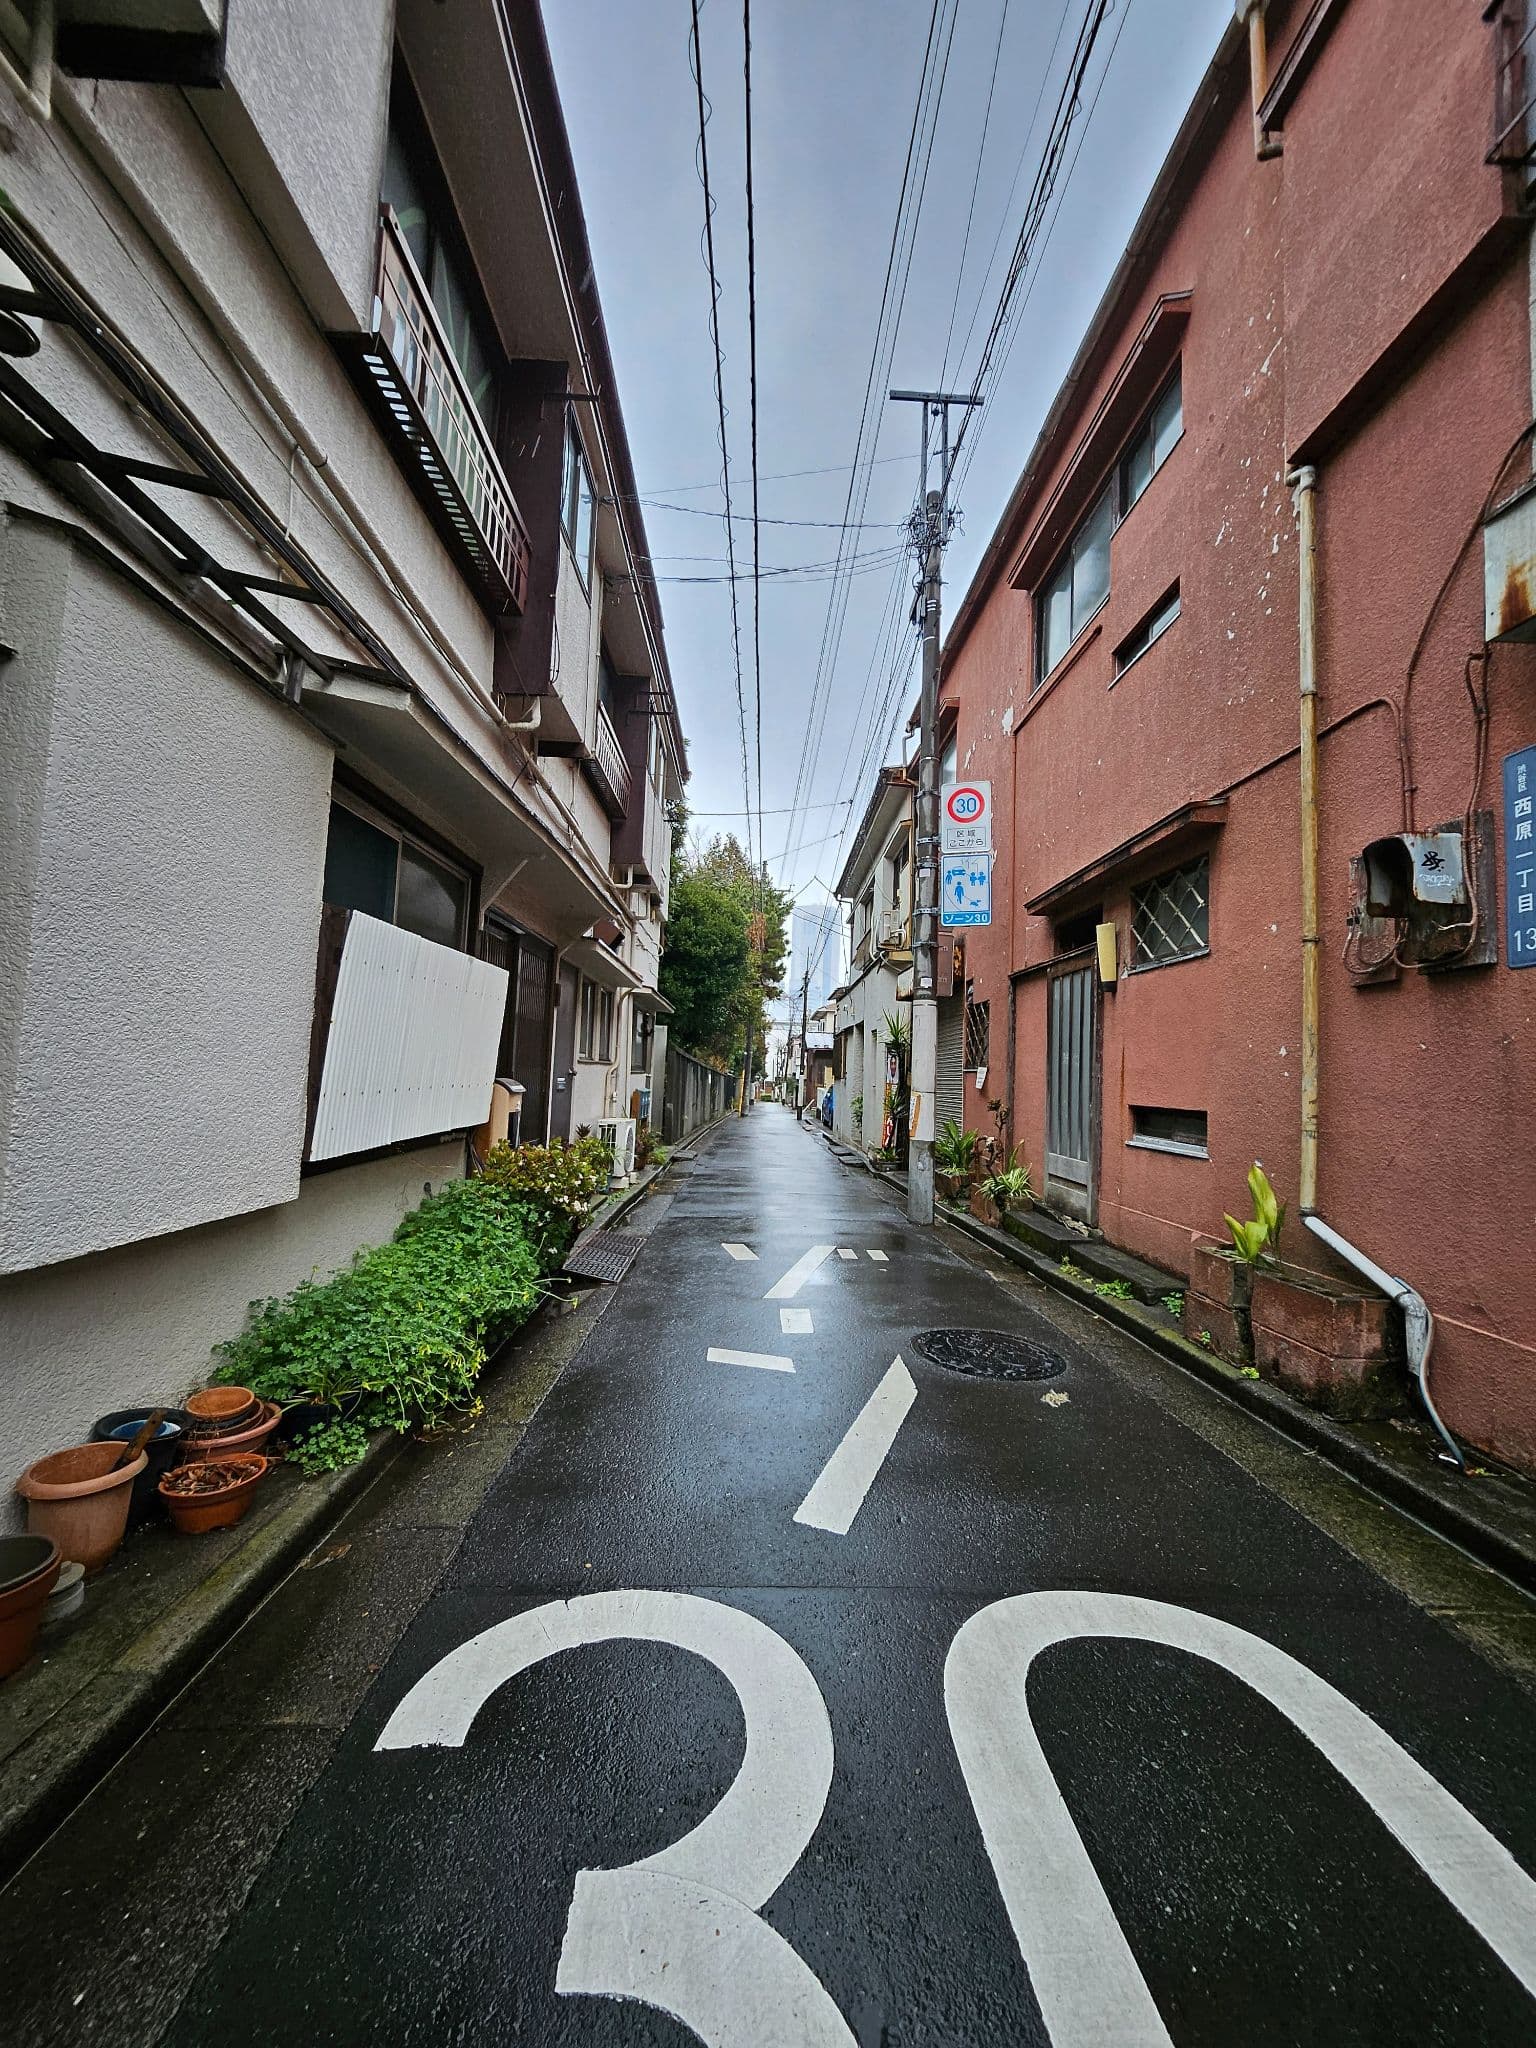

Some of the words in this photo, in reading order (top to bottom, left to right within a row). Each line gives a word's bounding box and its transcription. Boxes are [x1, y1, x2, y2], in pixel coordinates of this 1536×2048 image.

[956, 797, 977, 814] 30
[949, 838, 984, 848] ここから
[1514, 796, 1534, 914] 西原一丁目
[945, 912, 988, 924] ゾーン30
[1514, 927, 1536, 952] 13
